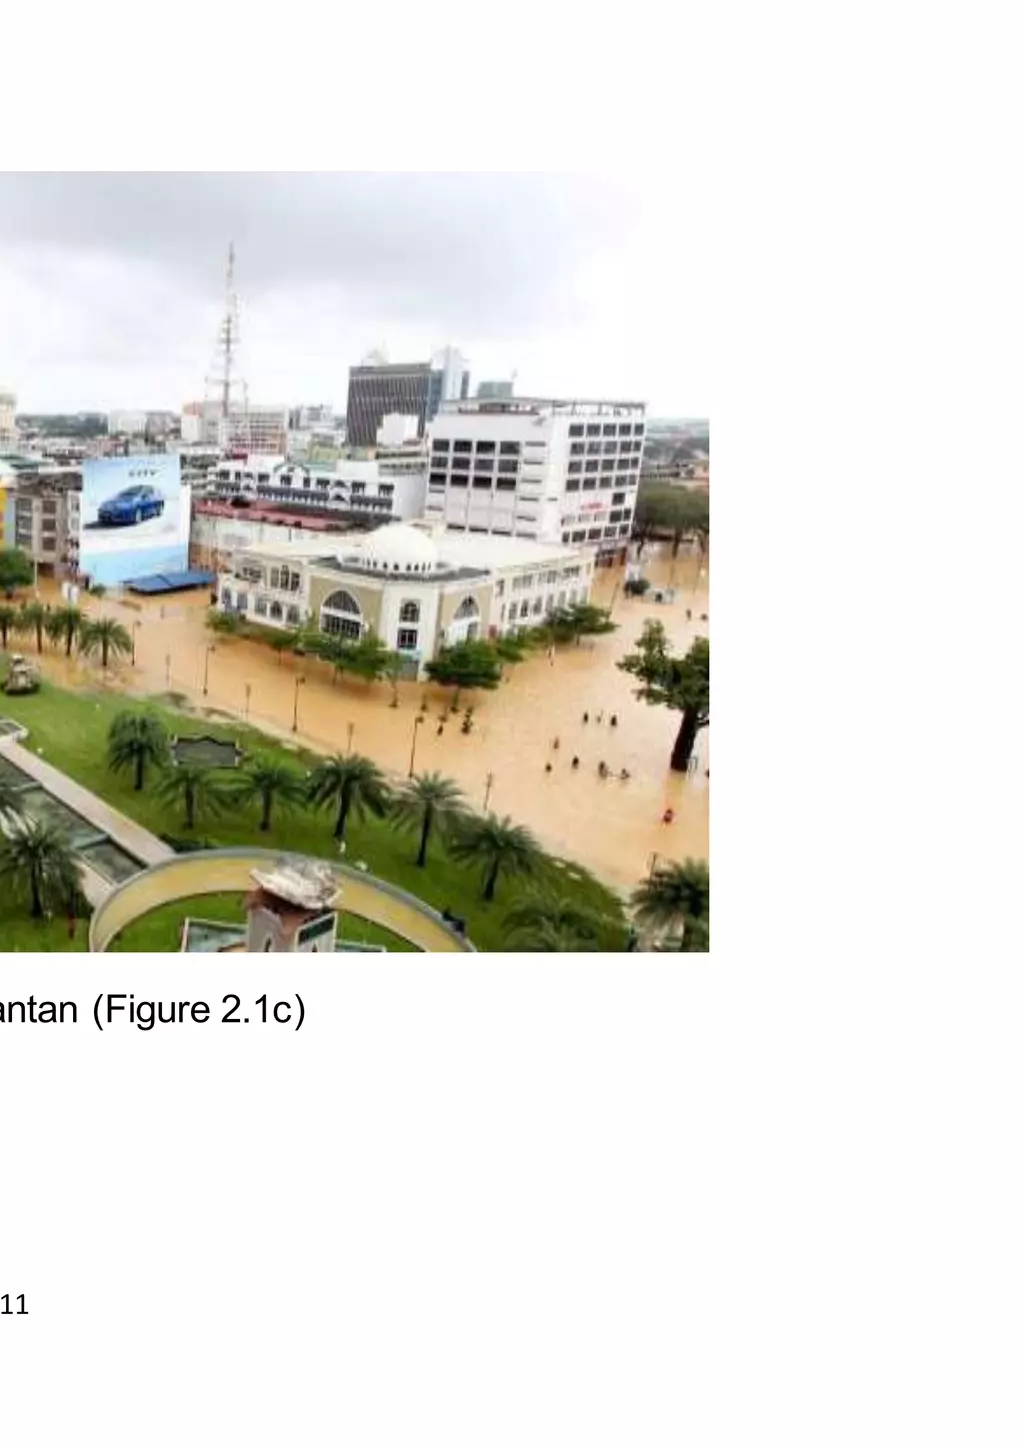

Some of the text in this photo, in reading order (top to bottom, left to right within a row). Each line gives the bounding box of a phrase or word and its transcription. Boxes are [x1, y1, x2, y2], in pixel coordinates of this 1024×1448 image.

[94, 994, 210, 1031] (Figure
[222, 994, 304, 1031] 2.1c)
[1, 1294, 28, 1314] 11
